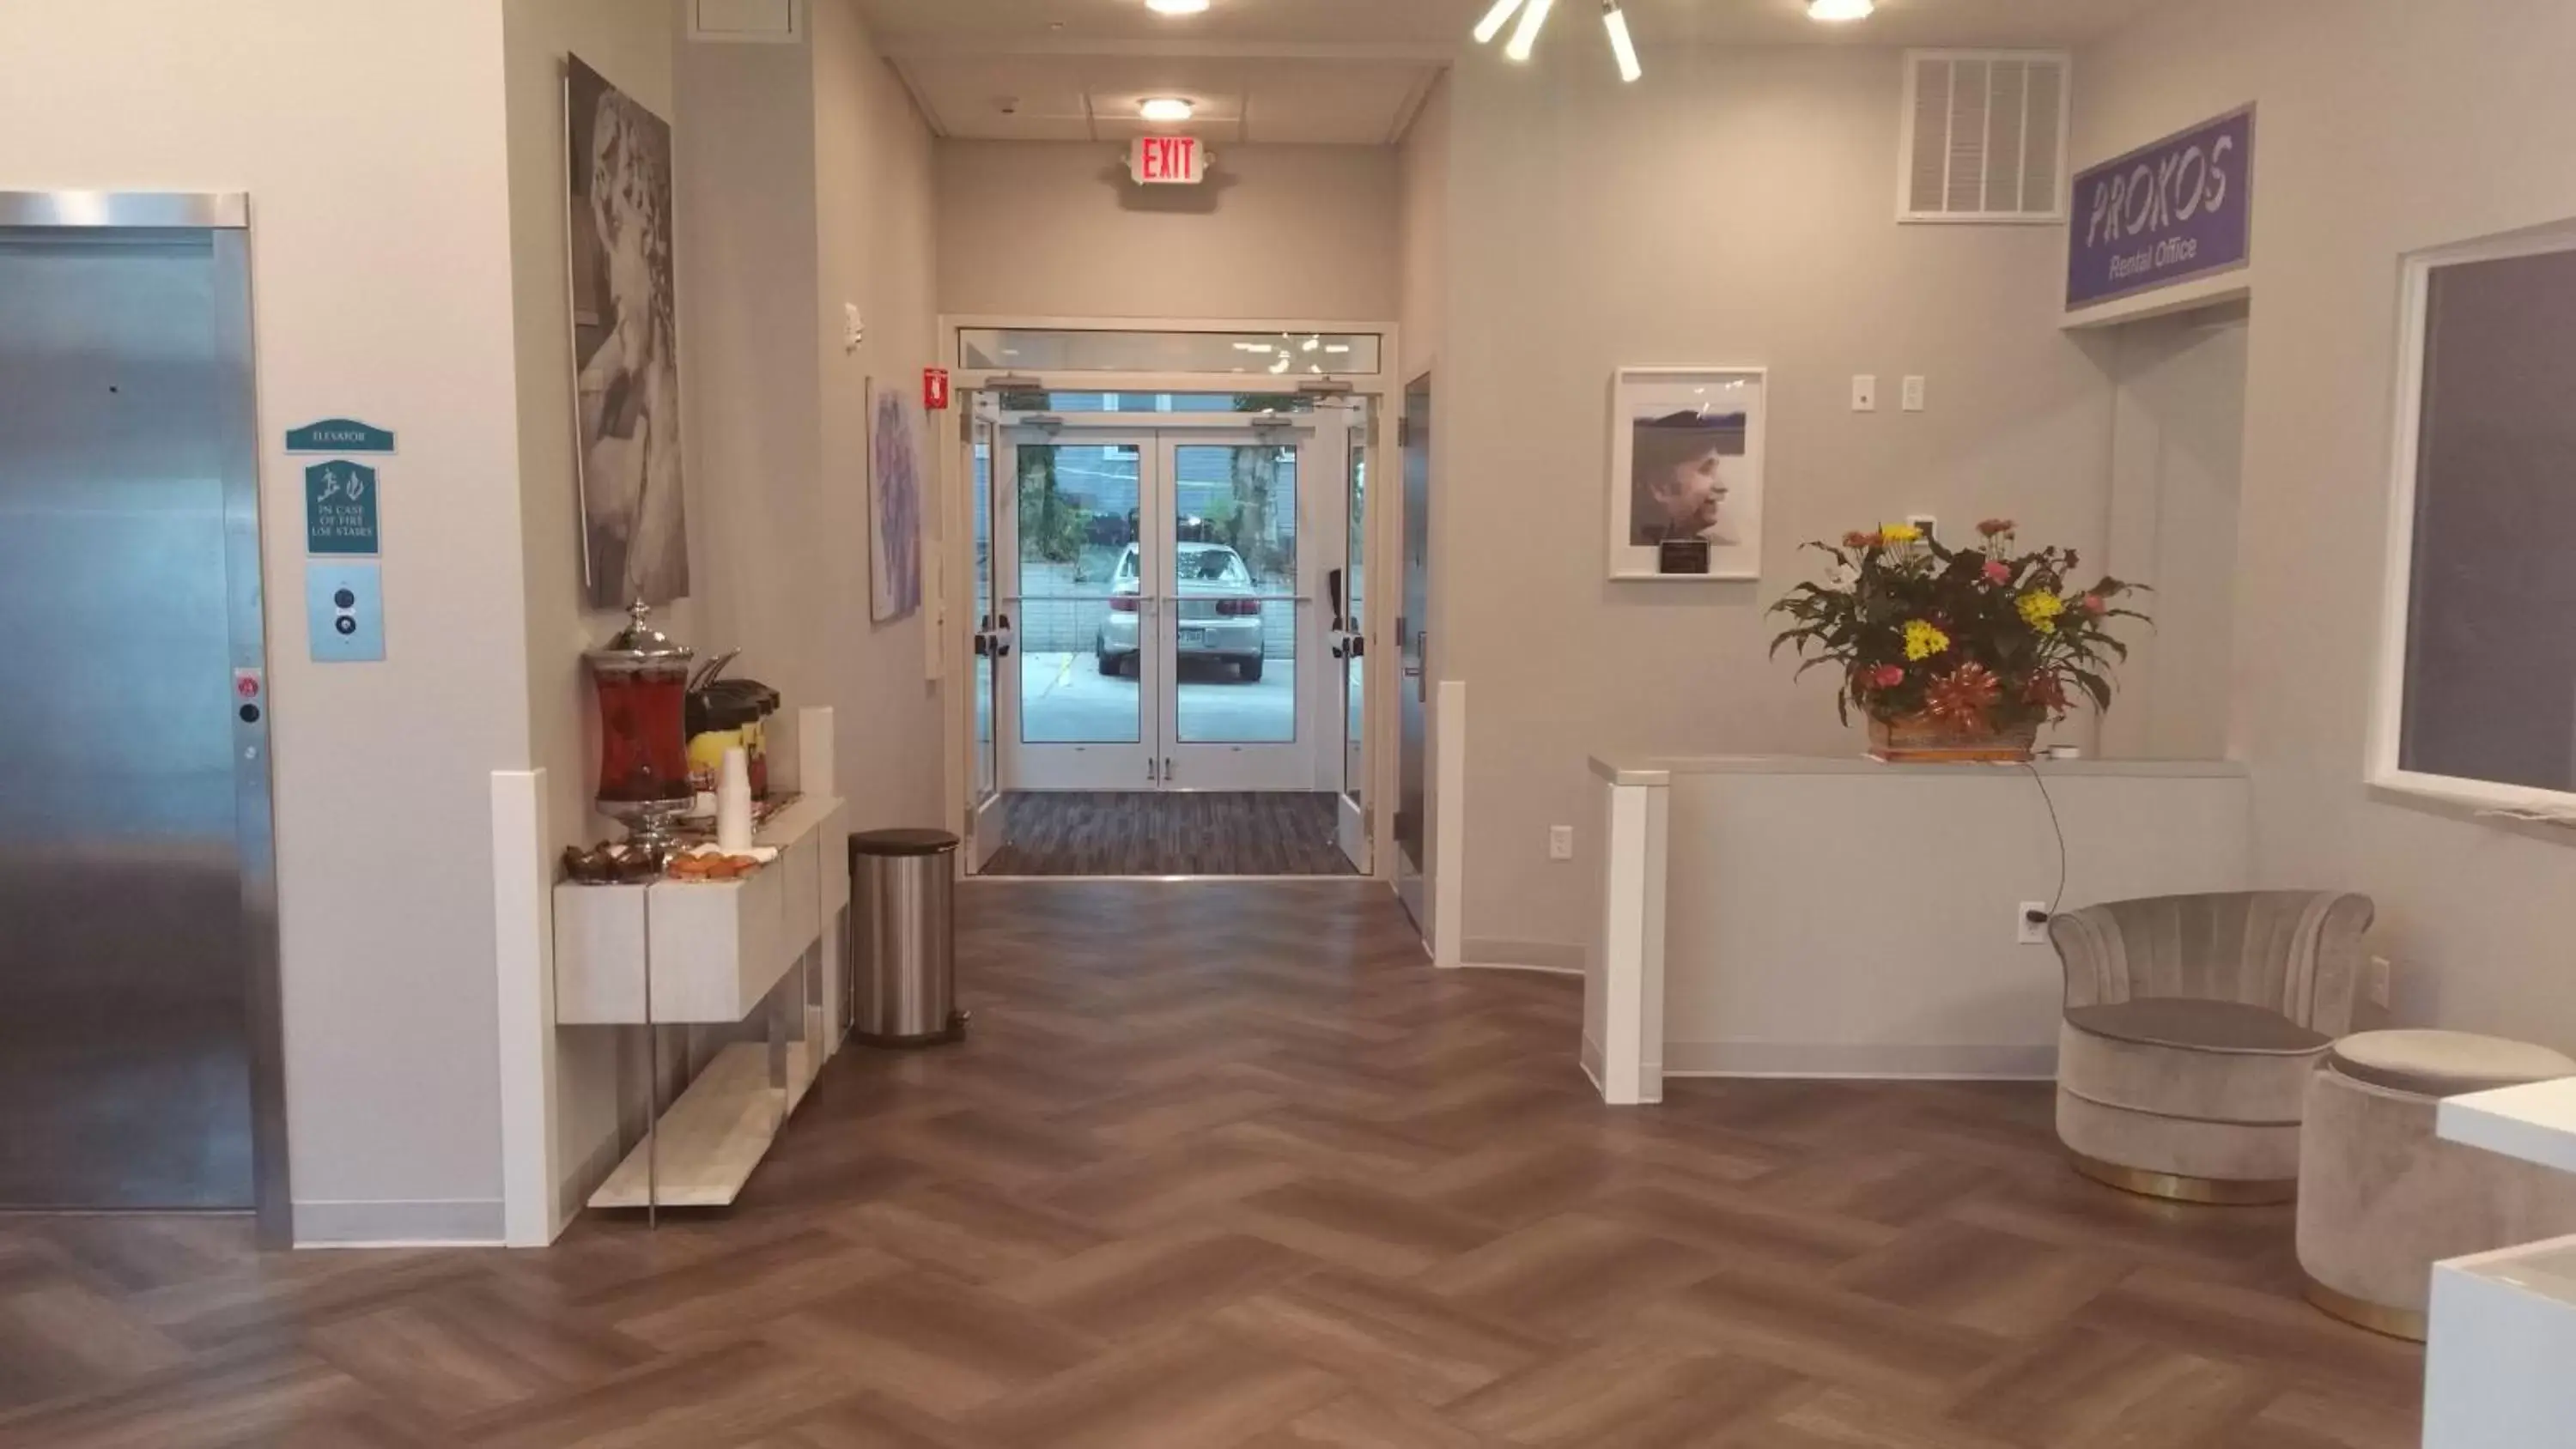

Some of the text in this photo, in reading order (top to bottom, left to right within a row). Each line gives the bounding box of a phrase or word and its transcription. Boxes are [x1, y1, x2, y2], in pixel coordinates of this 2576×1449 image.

[1143, 138, 1194, 179] EXIT
[2109, 236, 2197, 281] Rental Office
[313, 431, 366, 442] ELEVATOR
[318, 505, 365, 515] IN CASE
[319, 516, 364, 526] OF FIRE
[336, 526, 373, 537] STAIRS
